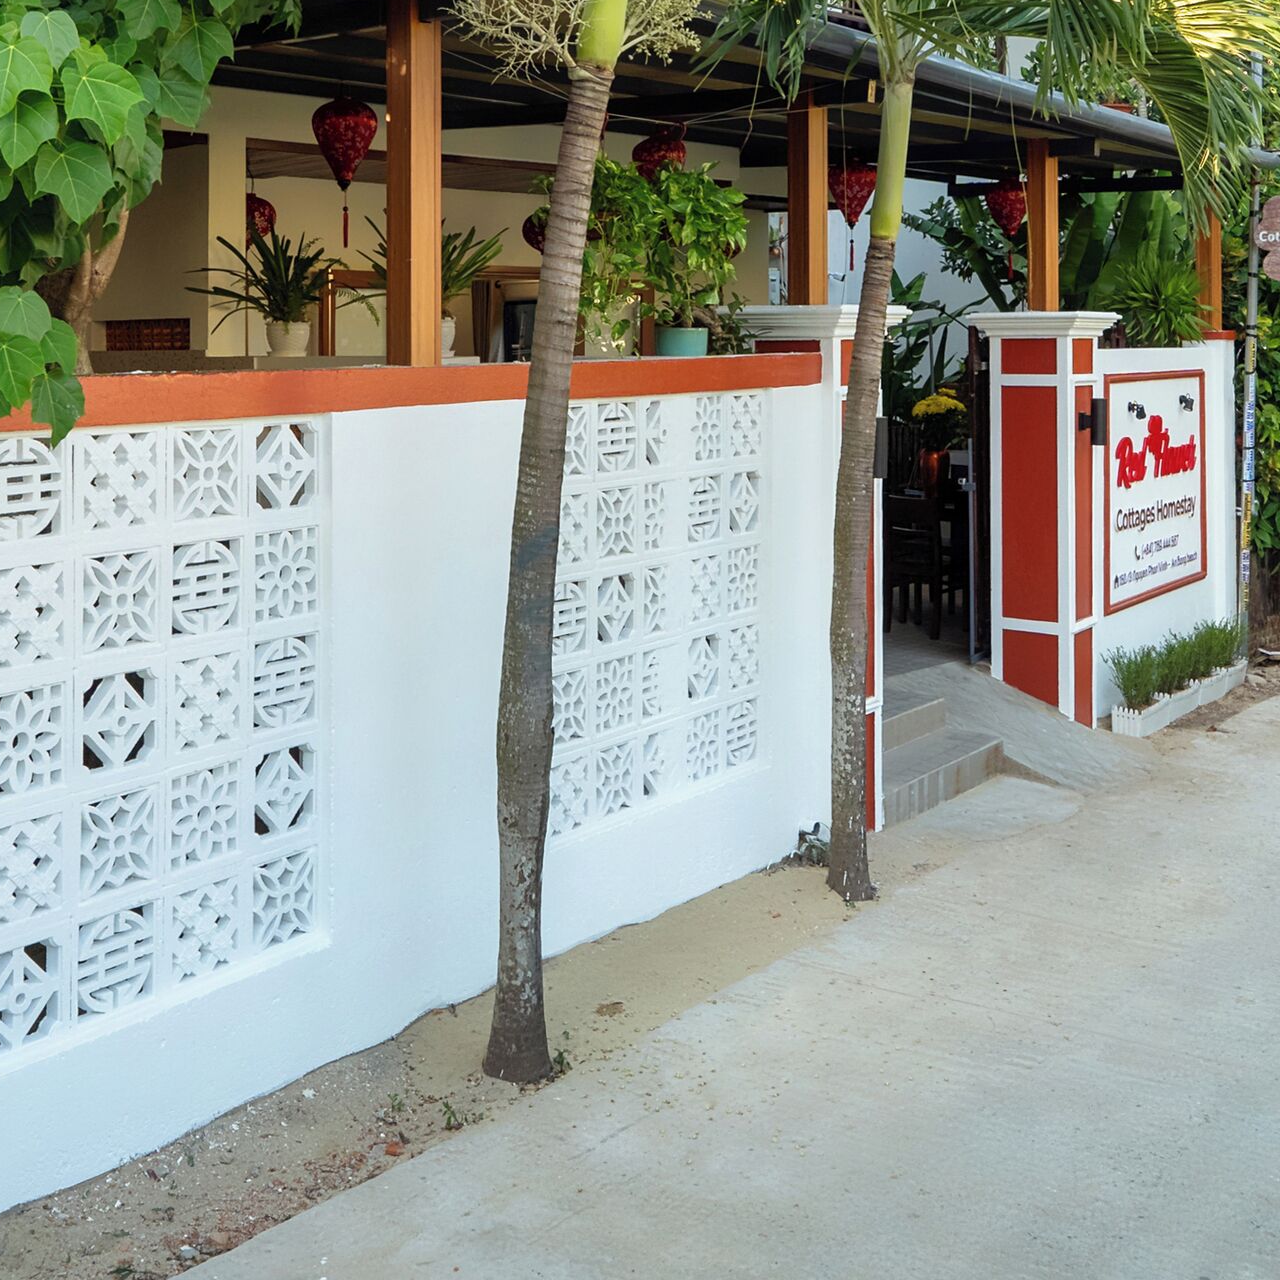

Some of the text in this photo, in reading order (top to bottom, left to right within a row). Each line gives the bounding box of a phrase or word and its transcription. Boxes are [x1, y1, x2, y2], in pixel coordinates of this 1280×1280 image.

[1115, 437, 1147, 490] Red
[1116, 495, 1196, 532] Cottages Homestay
